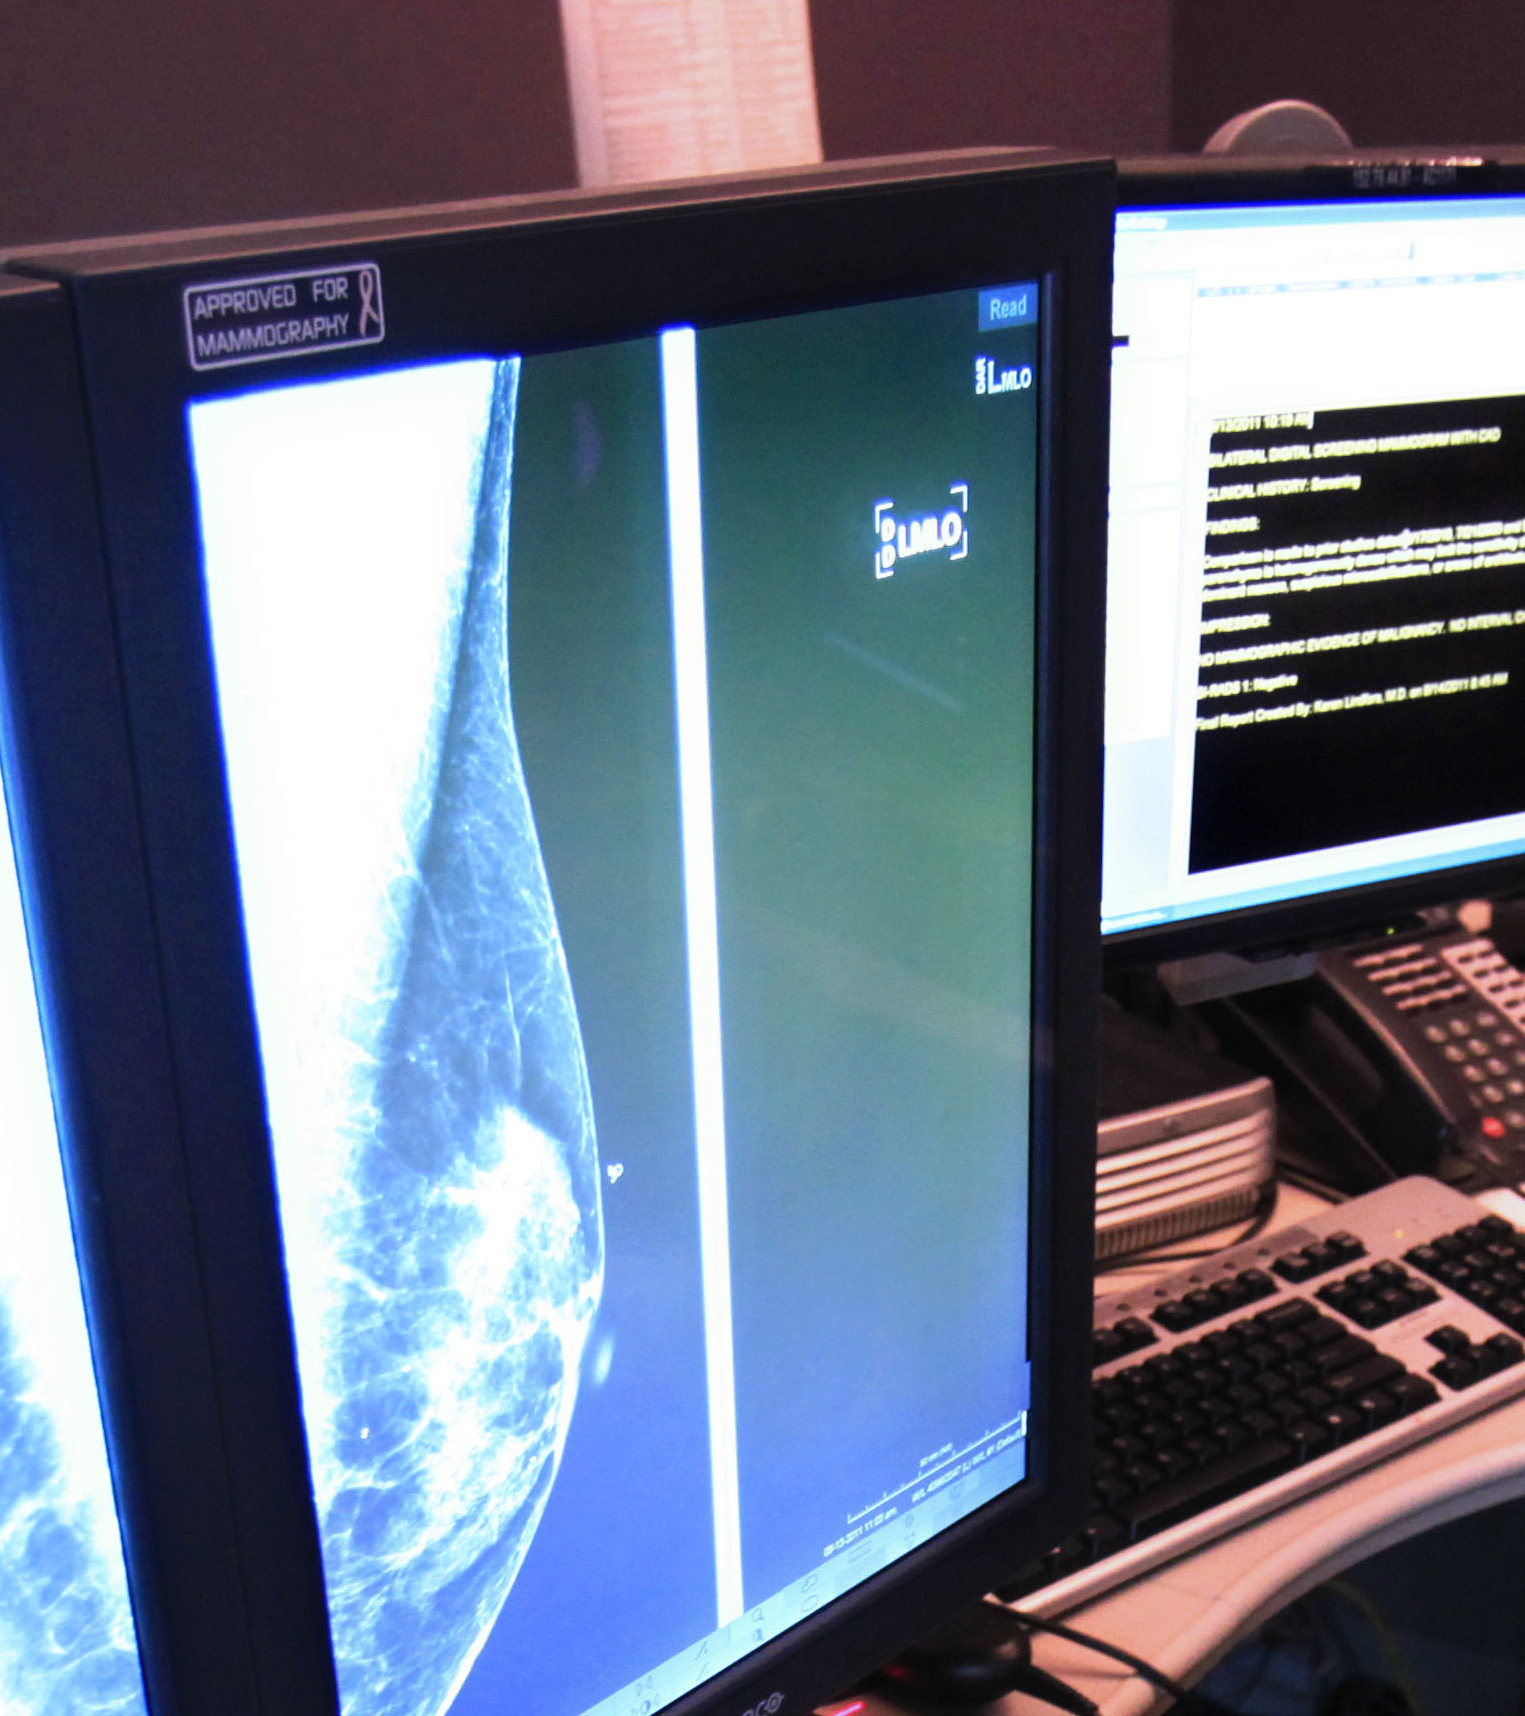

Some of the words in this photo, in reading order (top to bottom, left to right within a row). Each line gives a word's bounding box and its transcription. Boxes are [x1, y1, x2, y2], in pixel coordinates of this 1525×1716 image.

[193, 283, 297, 320] APPROVED
[312, 276, 348, 302] FOR
[990, 295, 1027, 320] Read
[196, 312, 350, 357] MAMMOGRAPHY
[898, 511, 962, 558] LMLO
